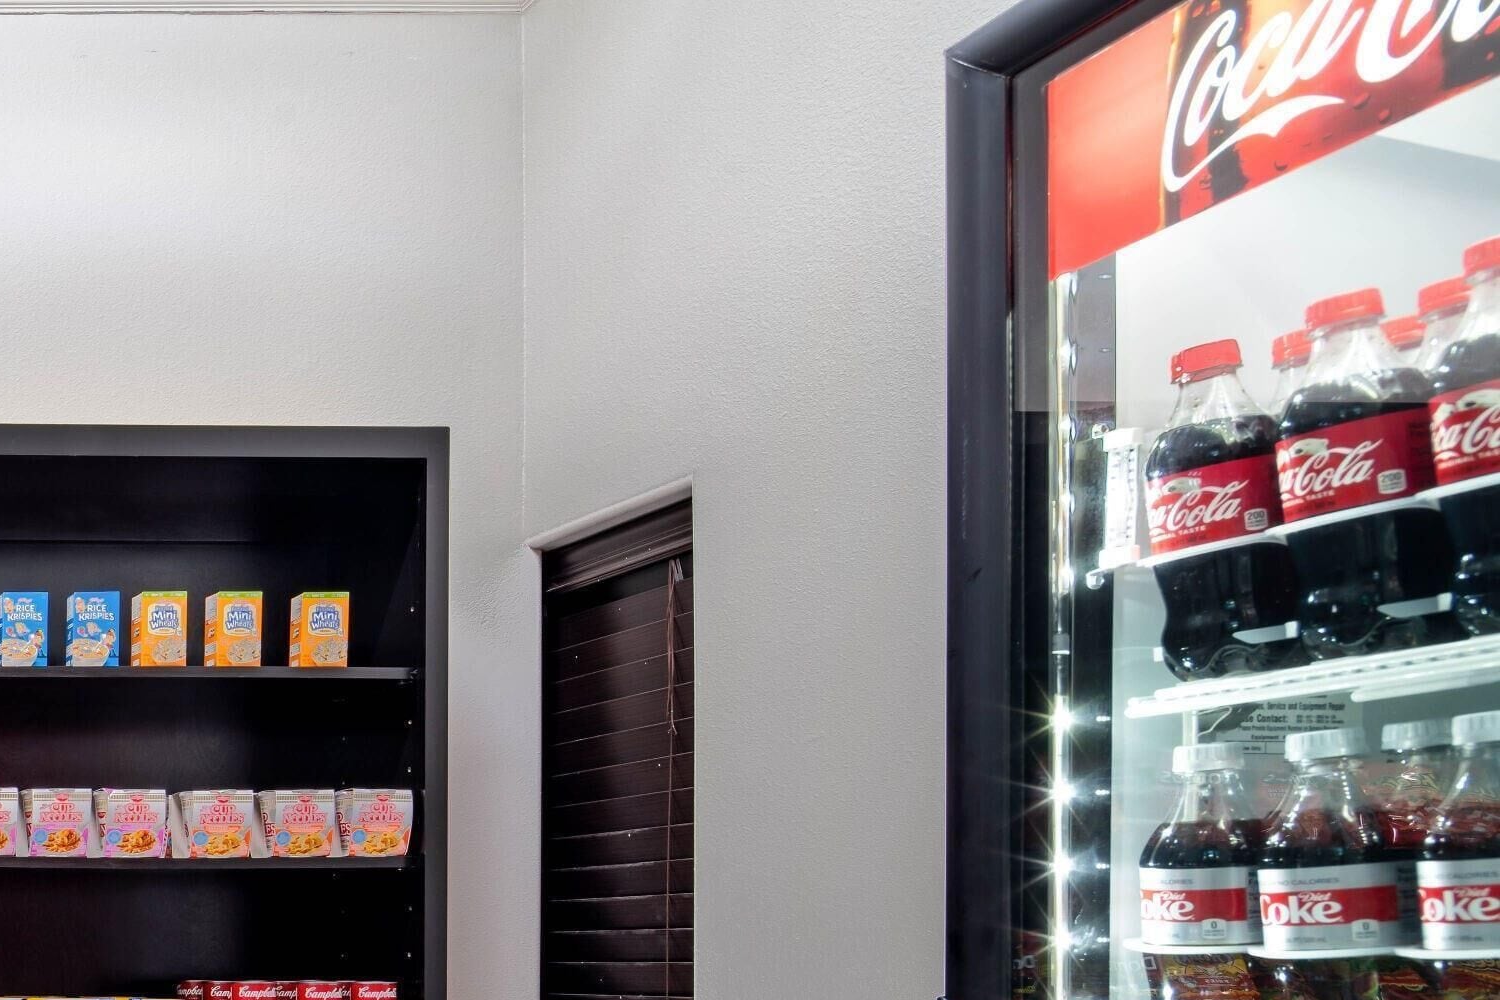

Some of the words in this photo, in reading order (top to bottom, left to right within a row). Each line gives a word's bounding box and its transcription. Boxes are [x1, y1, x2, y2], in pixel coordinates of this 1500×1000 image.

[1247, 510, 1265, 520] 200
[1179, 525, 1206, 536] TASTE
[16, 604, 35, 612] RICE
[87, 604, 107, 612] RICE
[8, 613, 42, 621] KRISPIES
[79, 613, 115, 621] KRISPIES
[152, 611, 177, 620] Mini
[228, 611, 252, 620] Mini
[313, 611, 338, 621] Mini
[50, 802, 75, 812] CUP
[124, 802, 150, 813] CUP
[210, 804, 236, 814] CUP
[292, 803, 318, 813] CUP
[370, 802, 396, 812] CUP
[39, 811, 83, 822] NOODLES
[112, 812, 159, 823] NOODLES
[200, 812, 245, 824] NOODLES
[283, 812, 326, 824] NOODLES
[358, 811, 404, 823] NOODLES
[1302, 892, 1332, 901] Diet
[1260, 895, 1343, 926] Coke
[1210, 920, 1218, 929] 0
